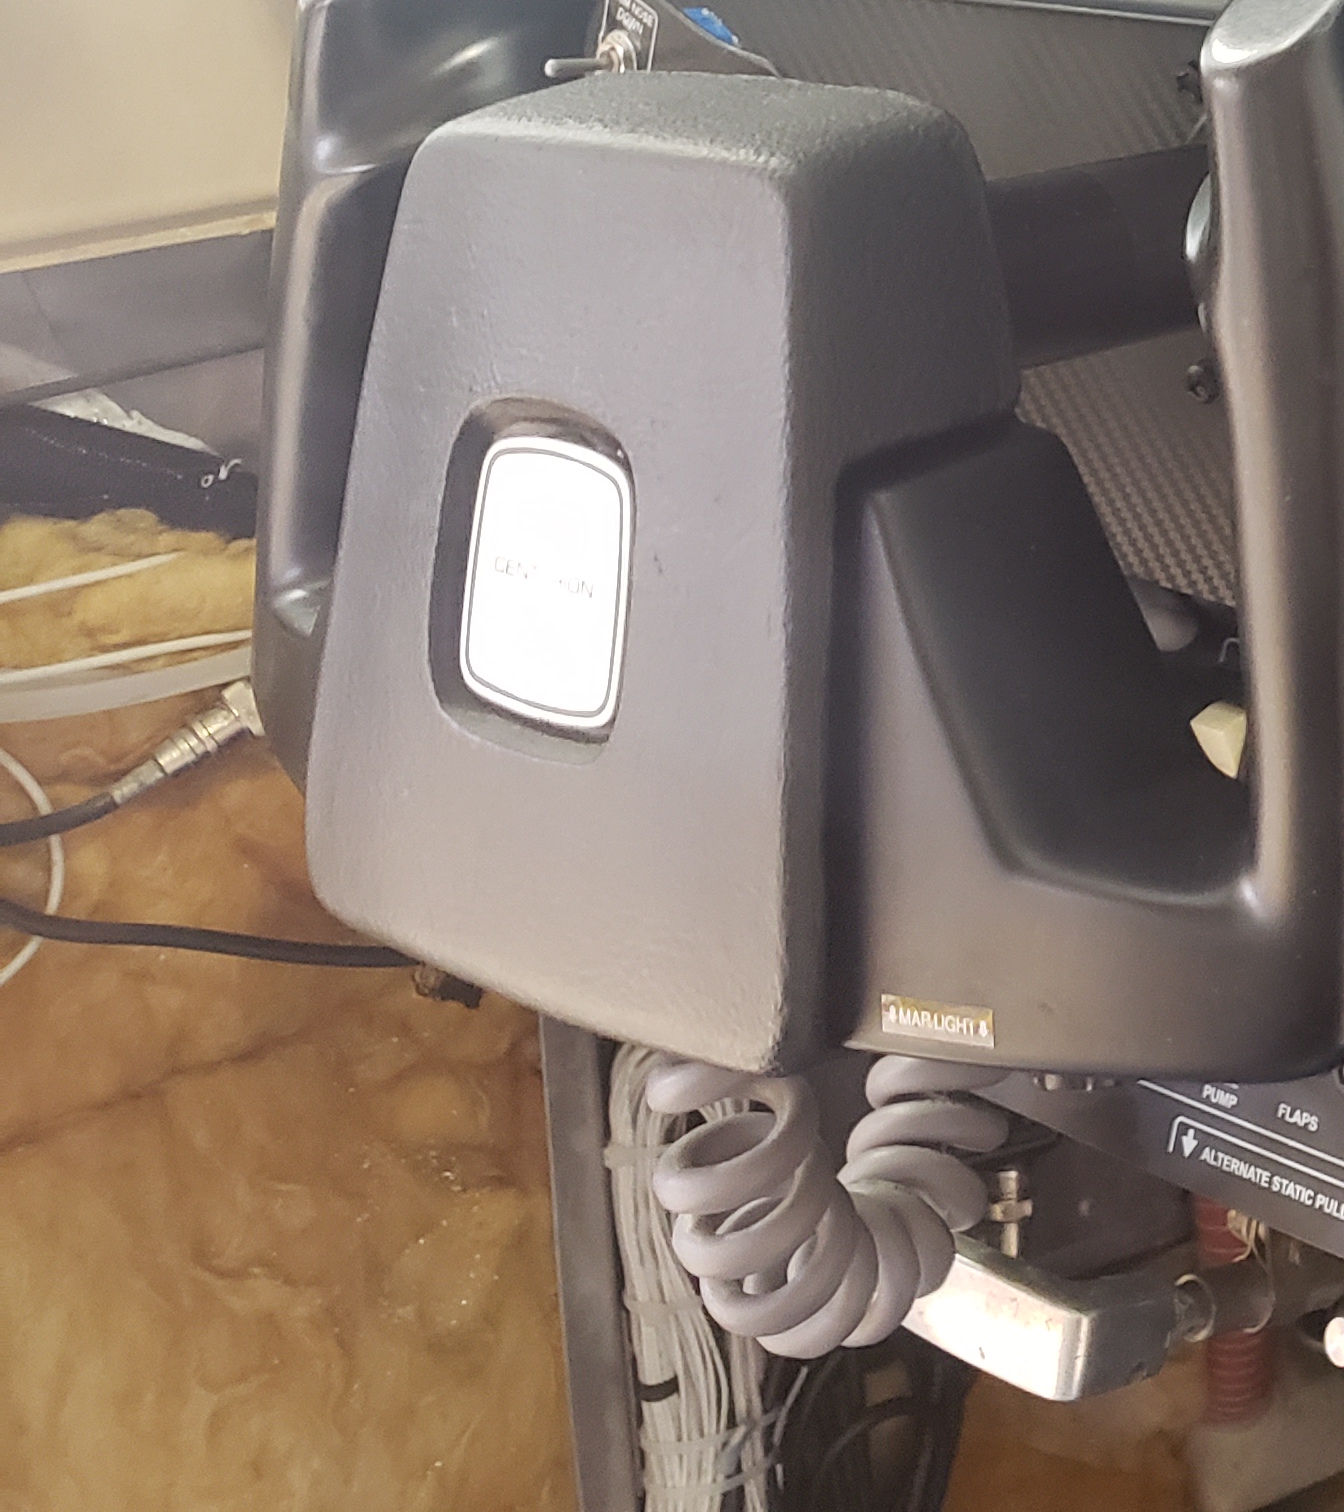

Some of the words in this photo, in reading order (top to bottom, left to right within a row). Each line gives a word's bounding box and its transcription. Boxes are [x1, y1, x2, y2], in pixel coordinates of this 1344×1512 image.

[1202, 1084, 1238, 1109] PUMP
[1276, 1103, 1320, 1132] FLAPS
[1199, 1145, 1271, 1190] ALTERNATE
[1271, 1174, 1315, 1207] STATIC
